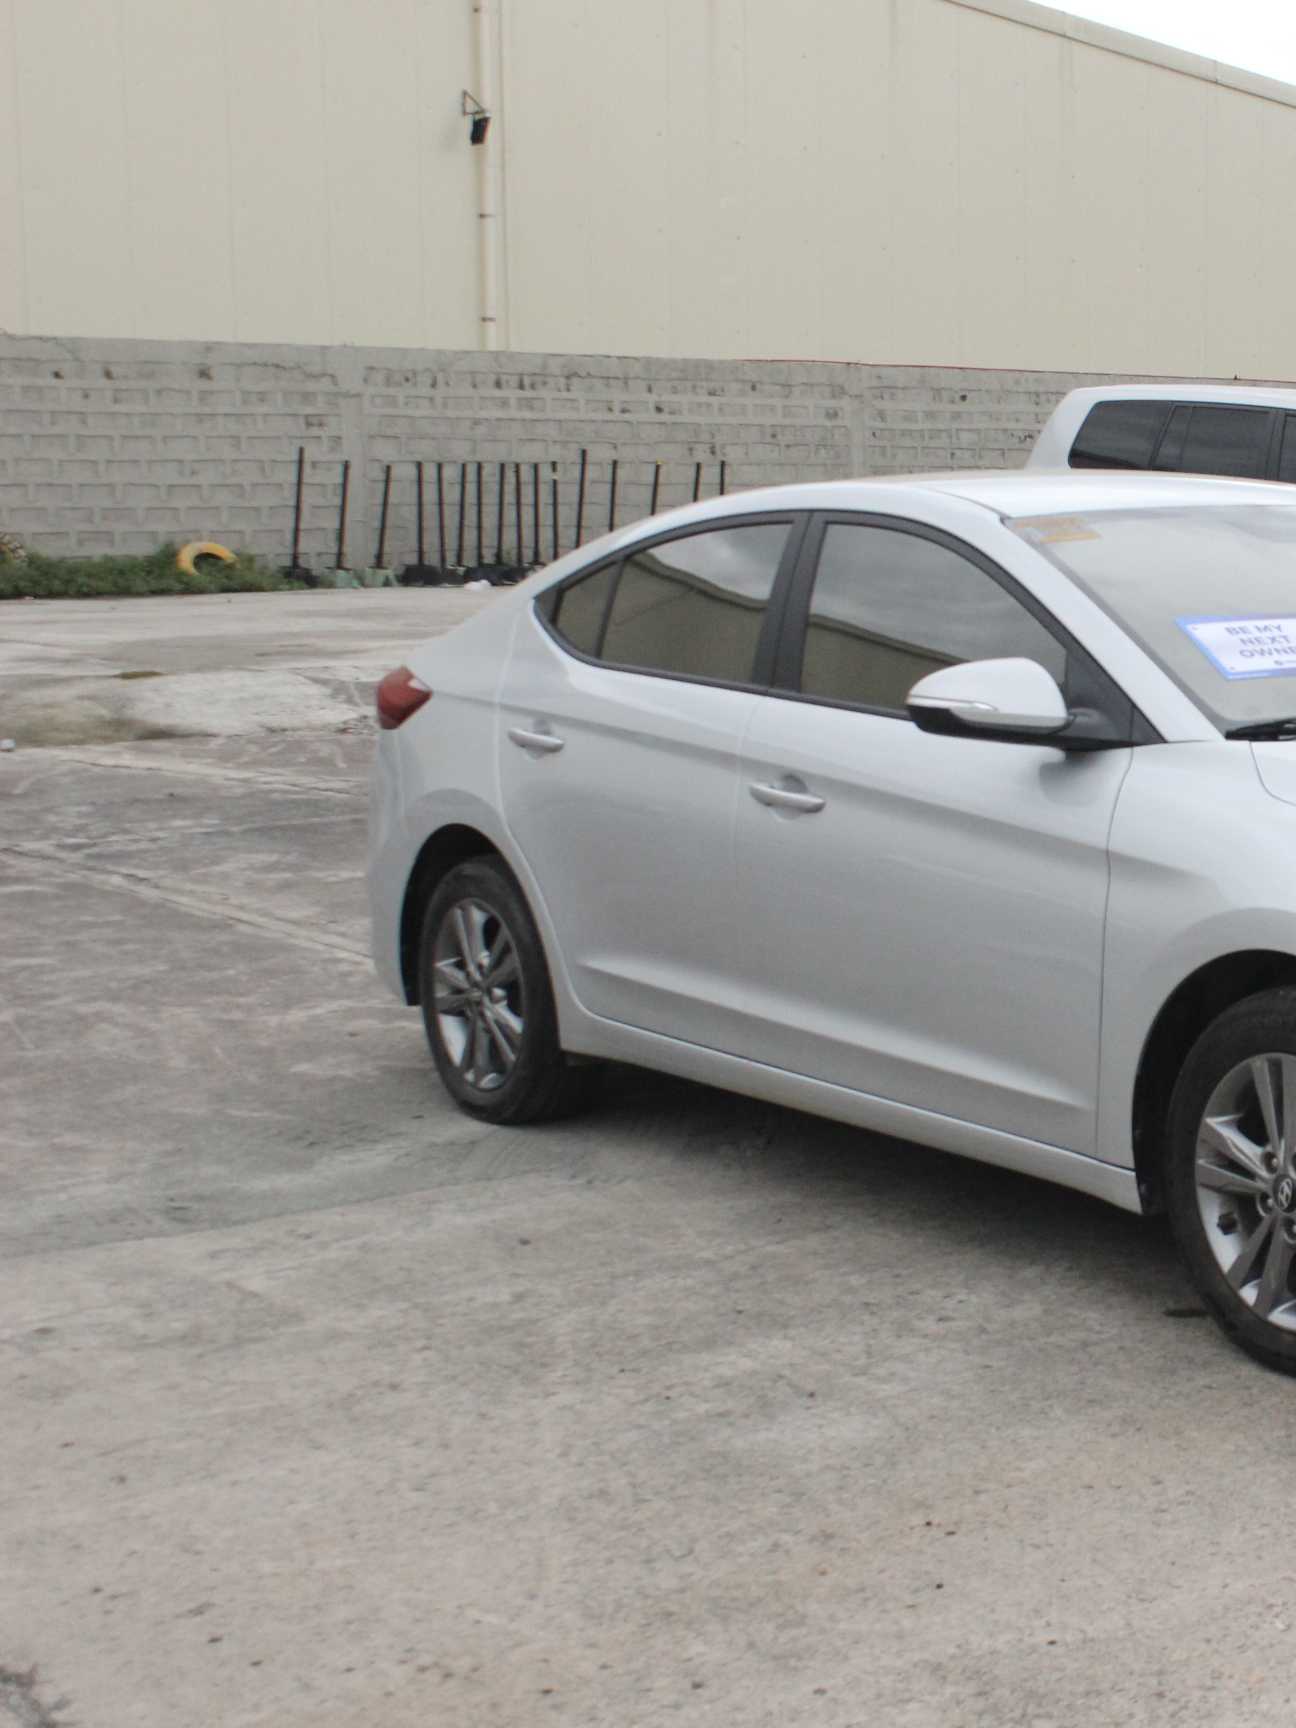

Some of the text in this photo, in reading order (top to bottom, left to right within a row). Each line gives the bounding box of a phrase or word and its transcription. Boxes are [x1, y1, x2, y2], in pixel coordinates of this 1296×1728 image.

[1224, 623, 1284, 636] BE MY
[1239, 634, 1292, 646] NEXT
